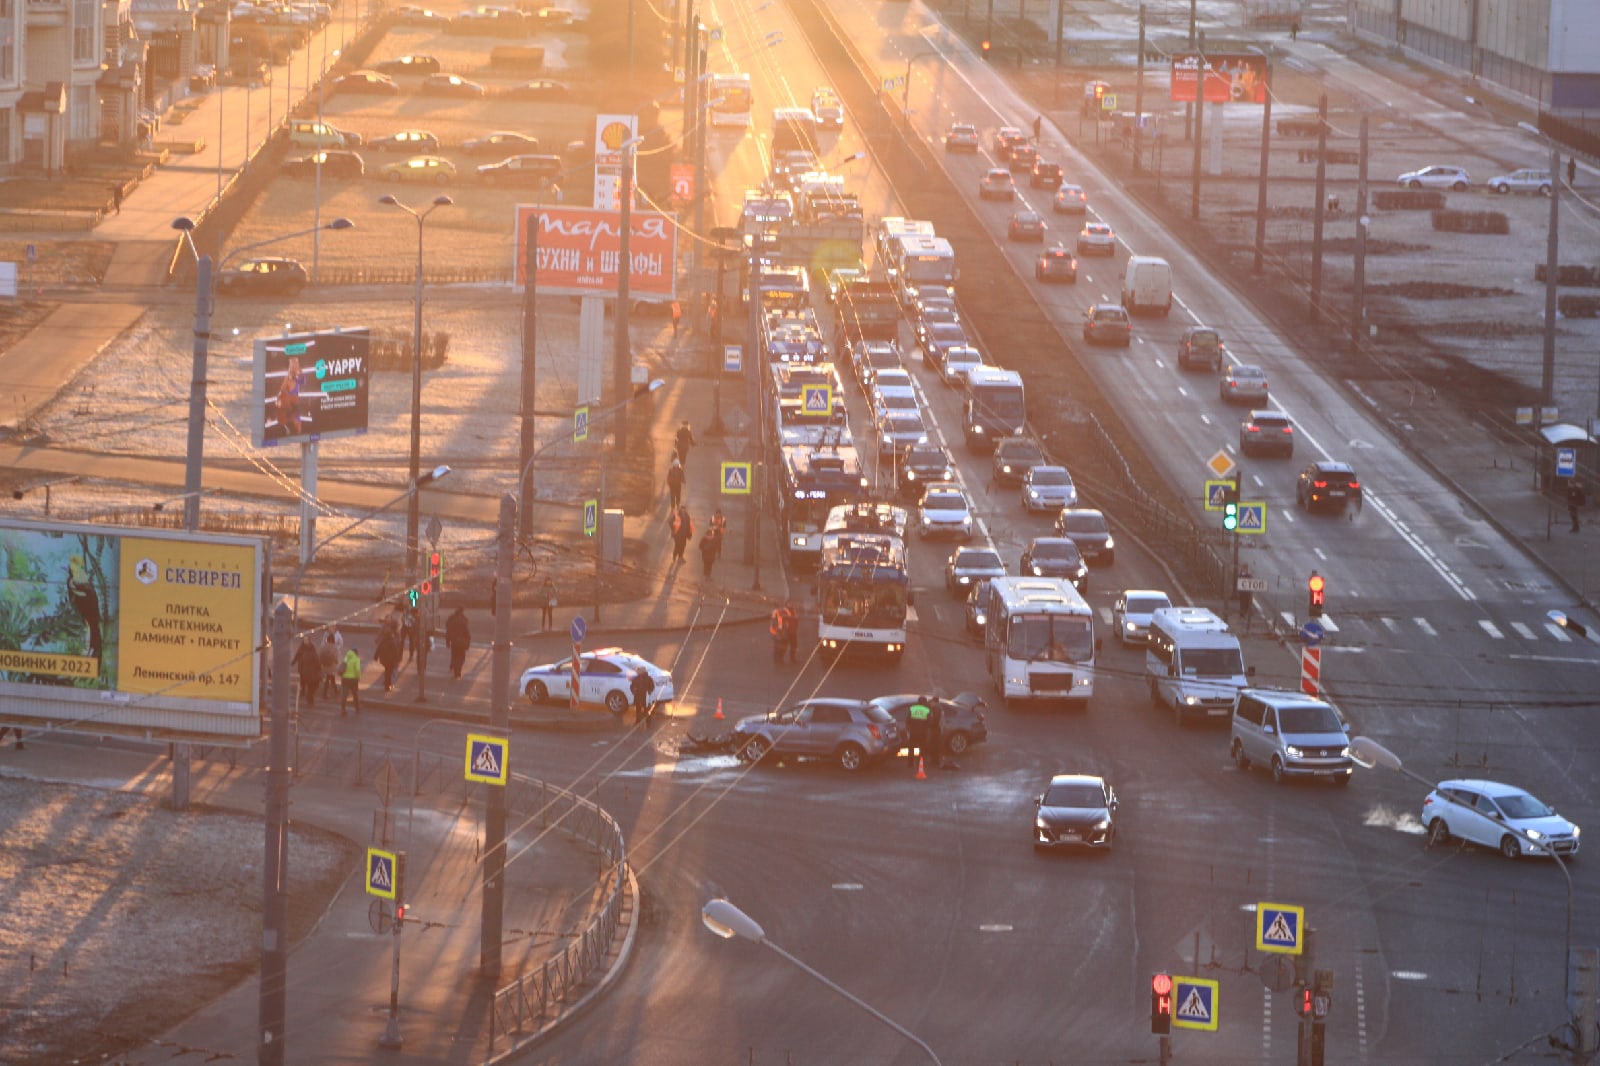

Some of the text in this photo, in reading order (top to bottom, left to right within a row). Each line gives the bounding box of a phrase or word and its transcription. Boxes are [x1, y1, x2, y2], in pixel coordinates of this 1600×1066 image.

[328, 357, 362, 376] YAPPY
[166, 603, 210, 617] ПЛИТКА
[151, 617, 223, 634] САНТЕХНИКА
[134, 631, 241, 650] ЛАМИНАТ ПАРКЕТ
[60, 659, 92, 674] 2022
[133, 665, 196, 683] Ленинский
[218, 673, 241, 687] 147
